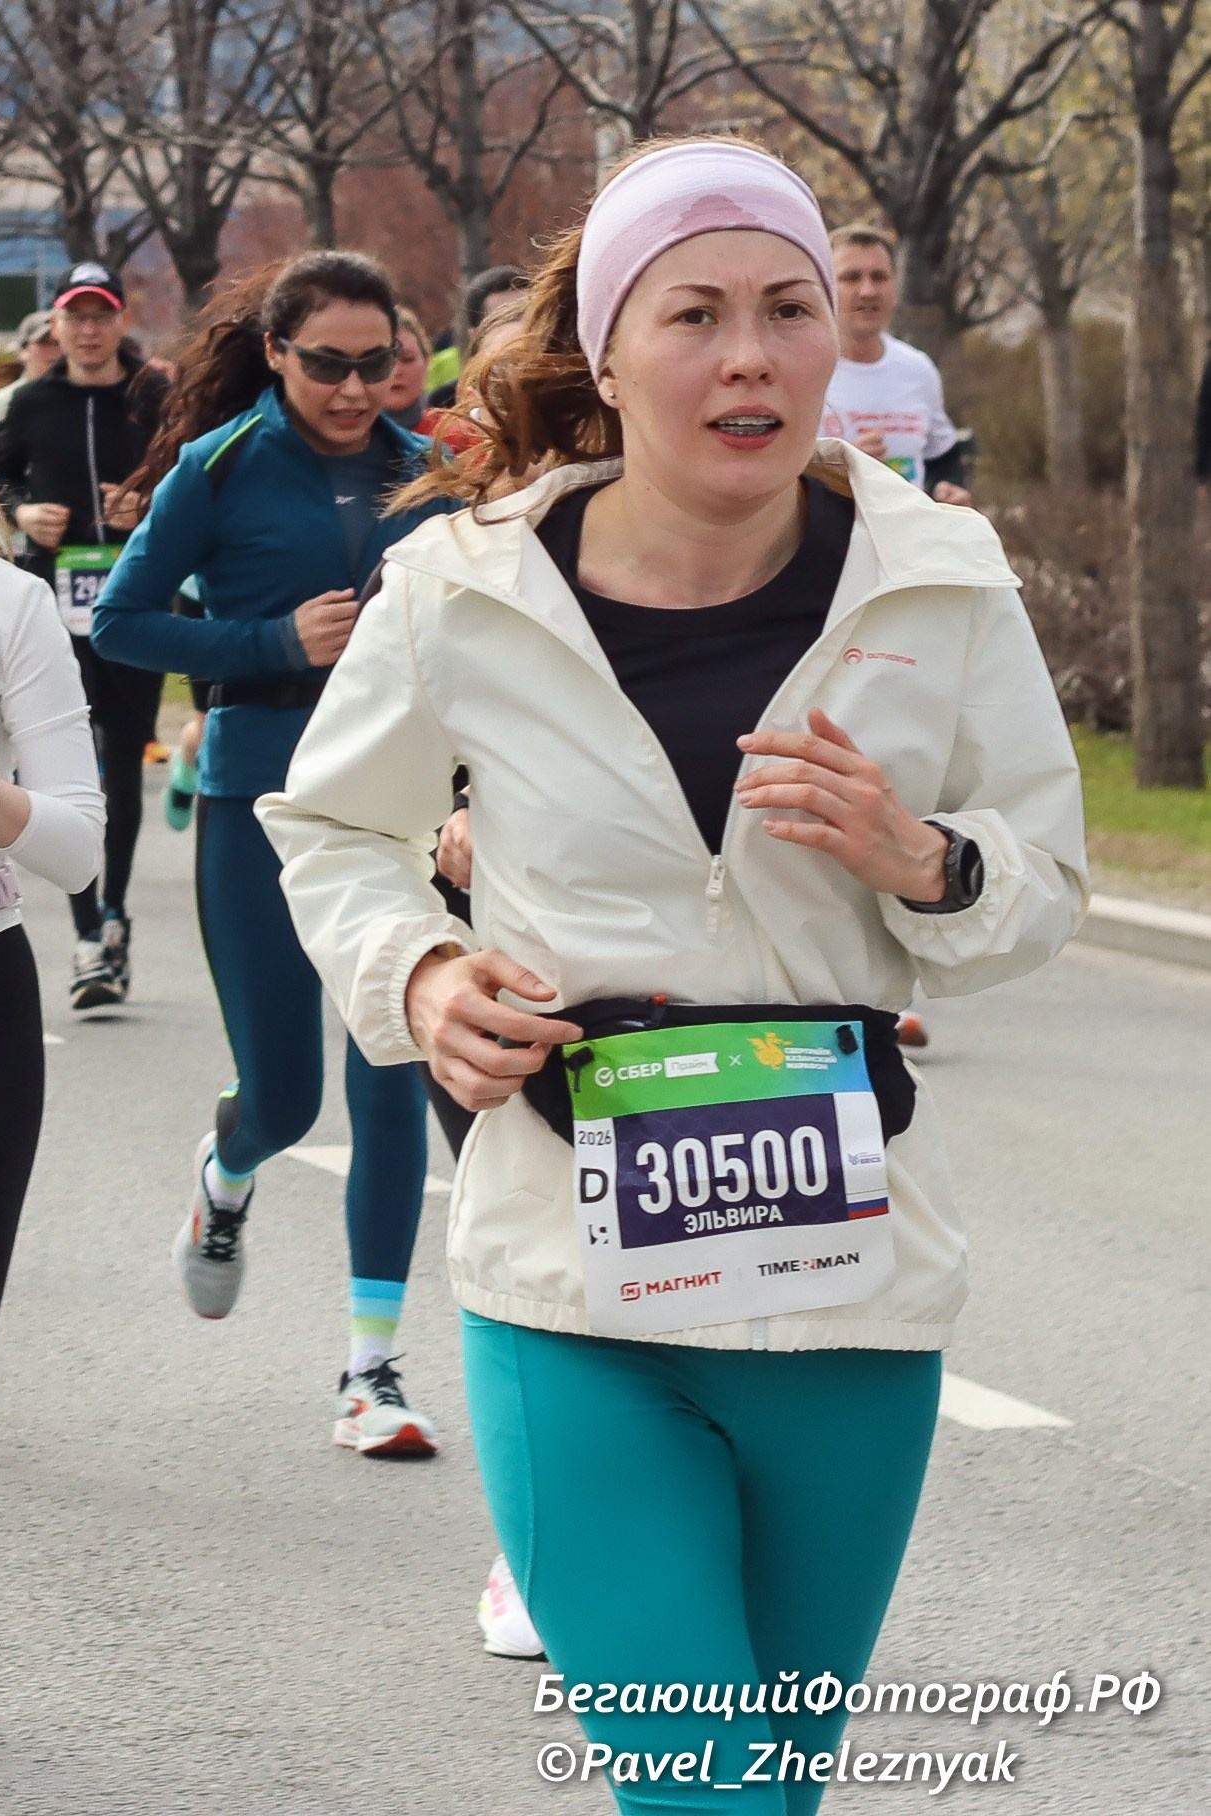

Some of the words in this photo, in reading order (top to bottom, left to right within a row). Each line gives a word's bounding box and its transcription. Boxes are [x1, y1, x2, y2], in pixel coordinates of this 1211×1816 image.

[616, 1062, 663, 1081] СБЕР
[578, 1129, 612, 1146] 2026
[636, 1125, 830, 1215] 30500
[579, 1167, 609, 1204] D
[683, 1203, 784, 1235] ЭЛЬВИРА
[645, 1271, 722, 1296] МАГНИТ
